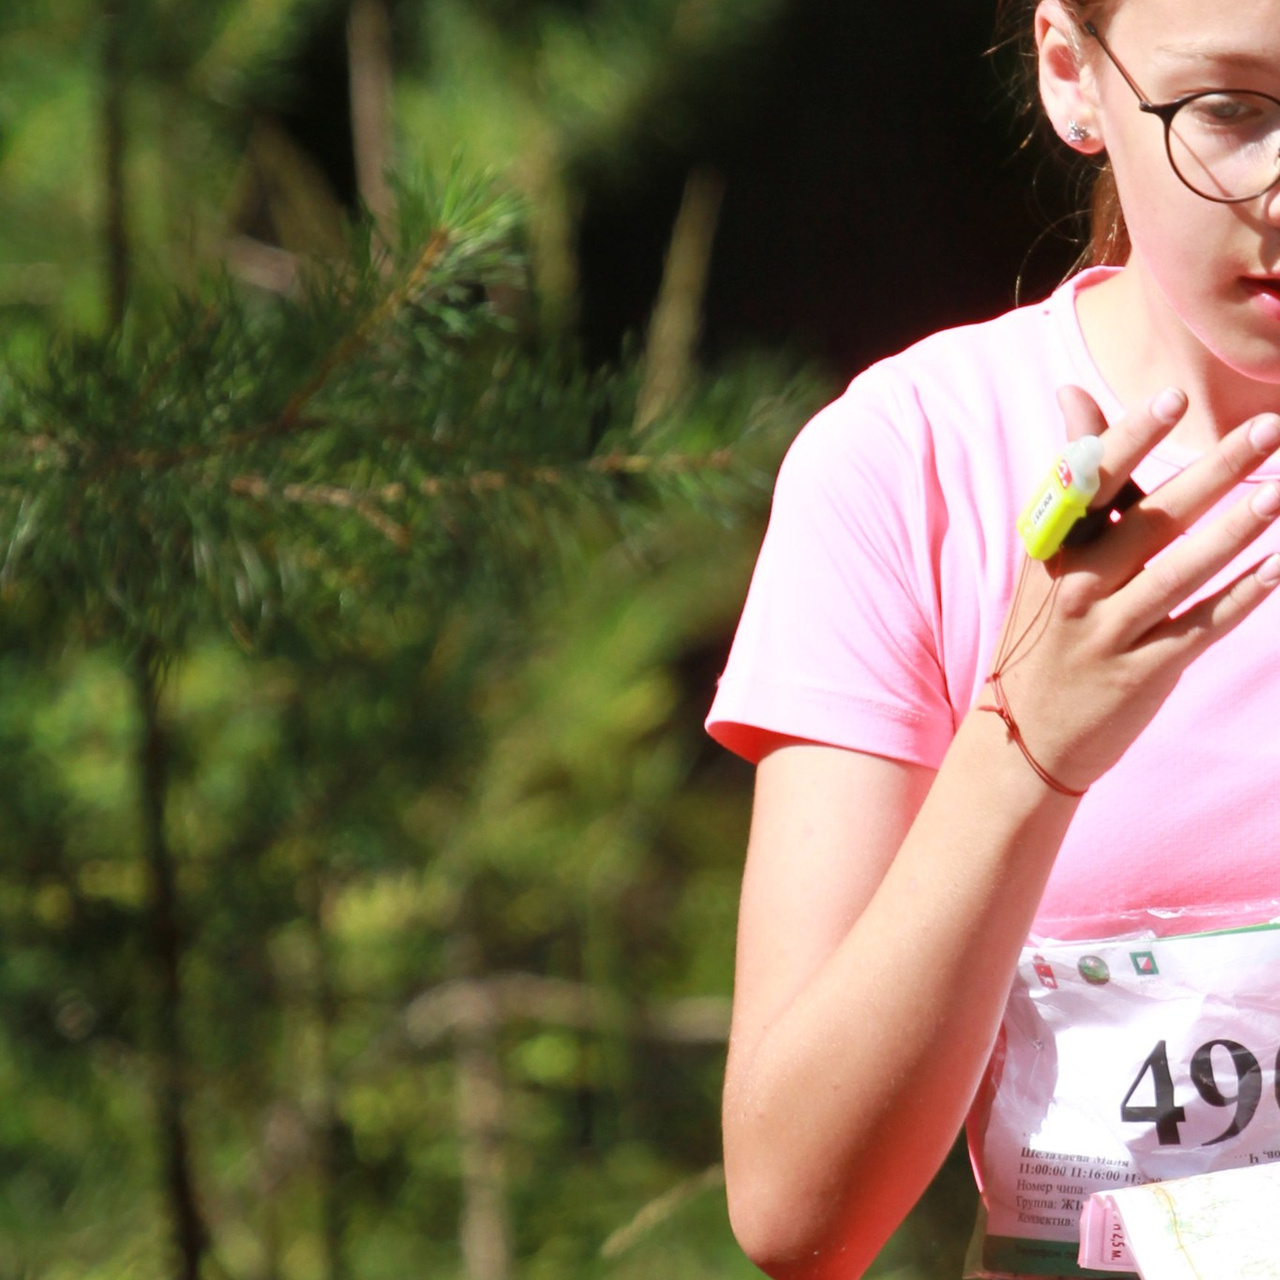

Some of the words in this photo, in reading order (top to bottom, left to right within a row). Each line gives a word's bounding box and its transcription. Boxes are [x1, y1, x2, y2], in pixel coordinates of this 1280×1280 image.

[1019, 1162, 1066, 1177] 11:00:00
[1070, 1166, 1120, 1182] 11:16:00
[1017, 1179, 1052, 1194] Номер
[1056, 1185, 1087, 1195] чипа:
[1016, 1196, 1057, 1210] Группа:
[1061, 1200, 1084, 1211] Ж1
